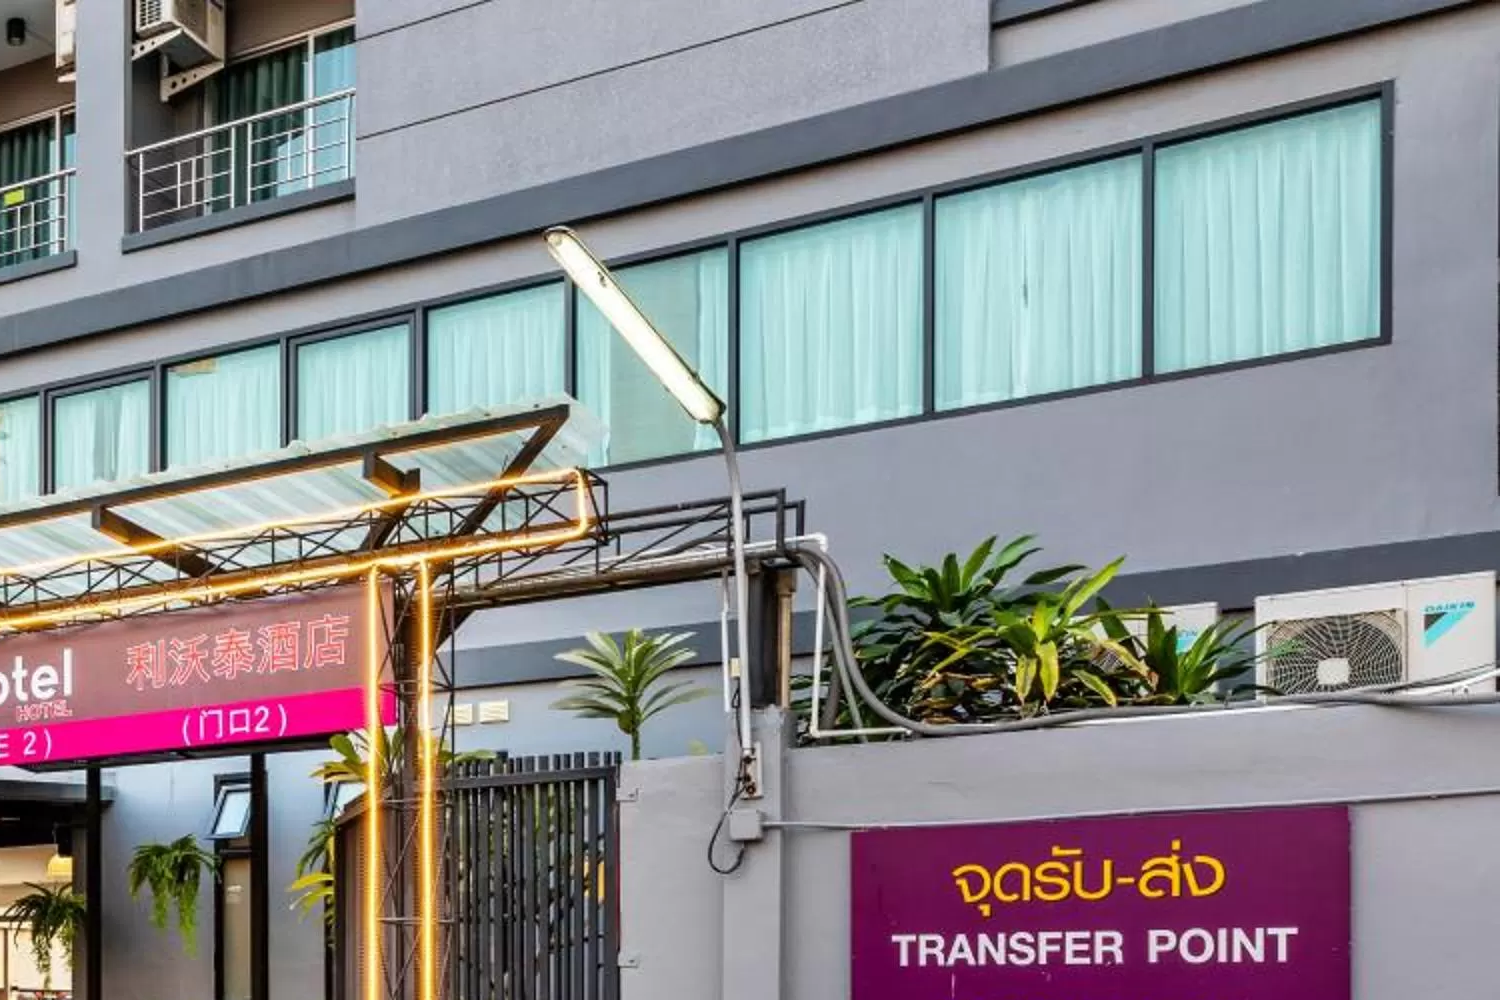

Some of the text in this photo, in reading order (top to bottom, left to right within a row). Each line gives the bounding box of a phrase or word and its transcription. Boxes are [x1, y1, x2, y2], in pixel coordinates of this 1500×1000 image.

[125, 613, 350, 691] 利沃泰酒店
[16, 699, 73, 722] HOTEL
[951, 839, 1226, 917] จุดรับ-ส่ง
[892, 926, 1299, 967] TRANSFER POINT
